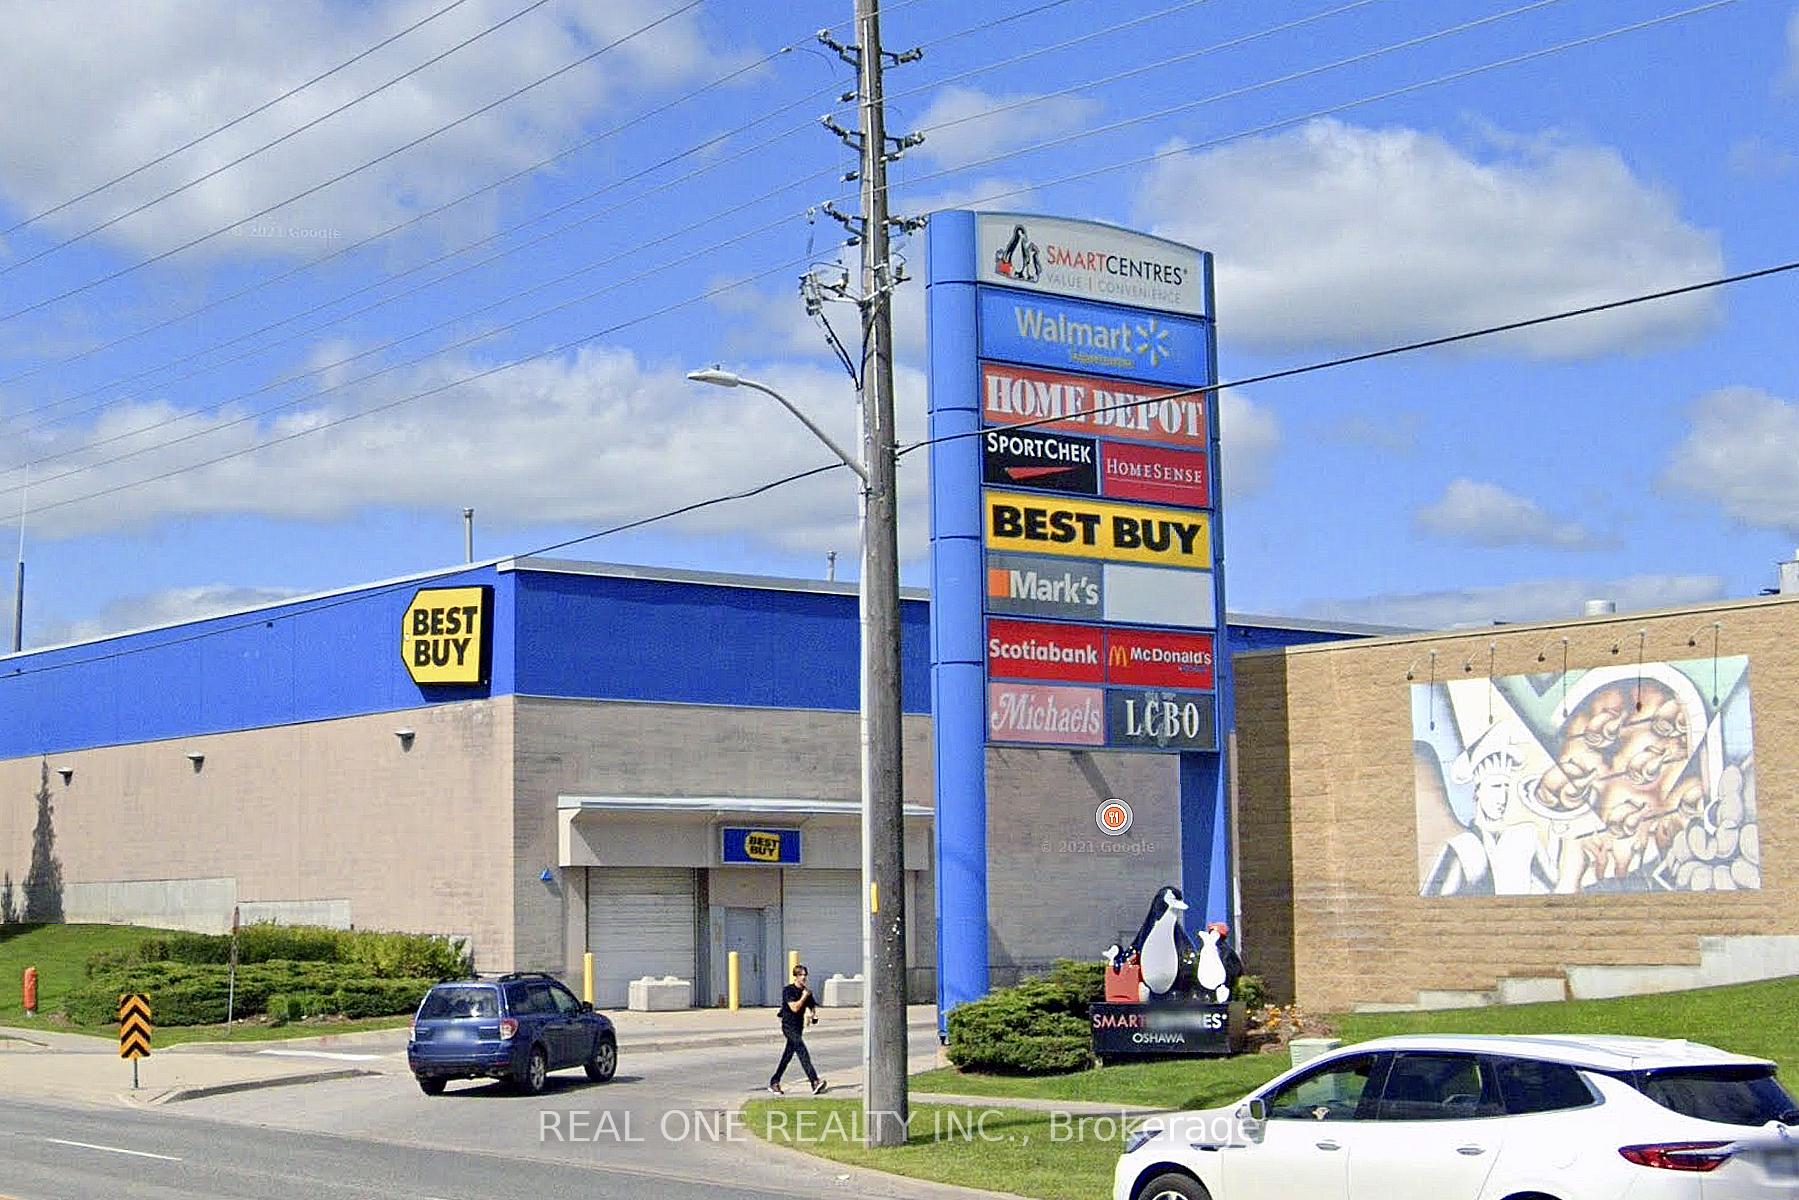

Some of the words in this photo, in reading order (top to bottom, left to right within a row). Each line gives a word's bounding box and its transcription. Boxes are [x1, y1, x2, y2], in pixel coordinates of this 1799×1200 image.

[1046, 244, 1183, 286] SMARTCENTRES
[1015, 305, 1132, 353] Walmart
[985, 374, 1084, 424] HOME
[1093, 389, 1203, 437] DEPOT
[991, 504, 1101, 546] BEST
[1112, 516, 1202, 555] BUY
[1009, 570, 1099, 606] Mark's
[413, 606, 478, 636] BEST
[414, 638, 472, 667] BUY
[989, 638, 1098, 665] Scotiabank
[1130, 647, 1212, 665] McDonald's
[991, 691, 1101, 735] Michaels
[1125, 699, 1199, 739] LCBO
[749, 836, 780, 848] BEST
[749, 845, 775, 856] BUY
[1131, 1032, 1185, 1044] OSHAWA
